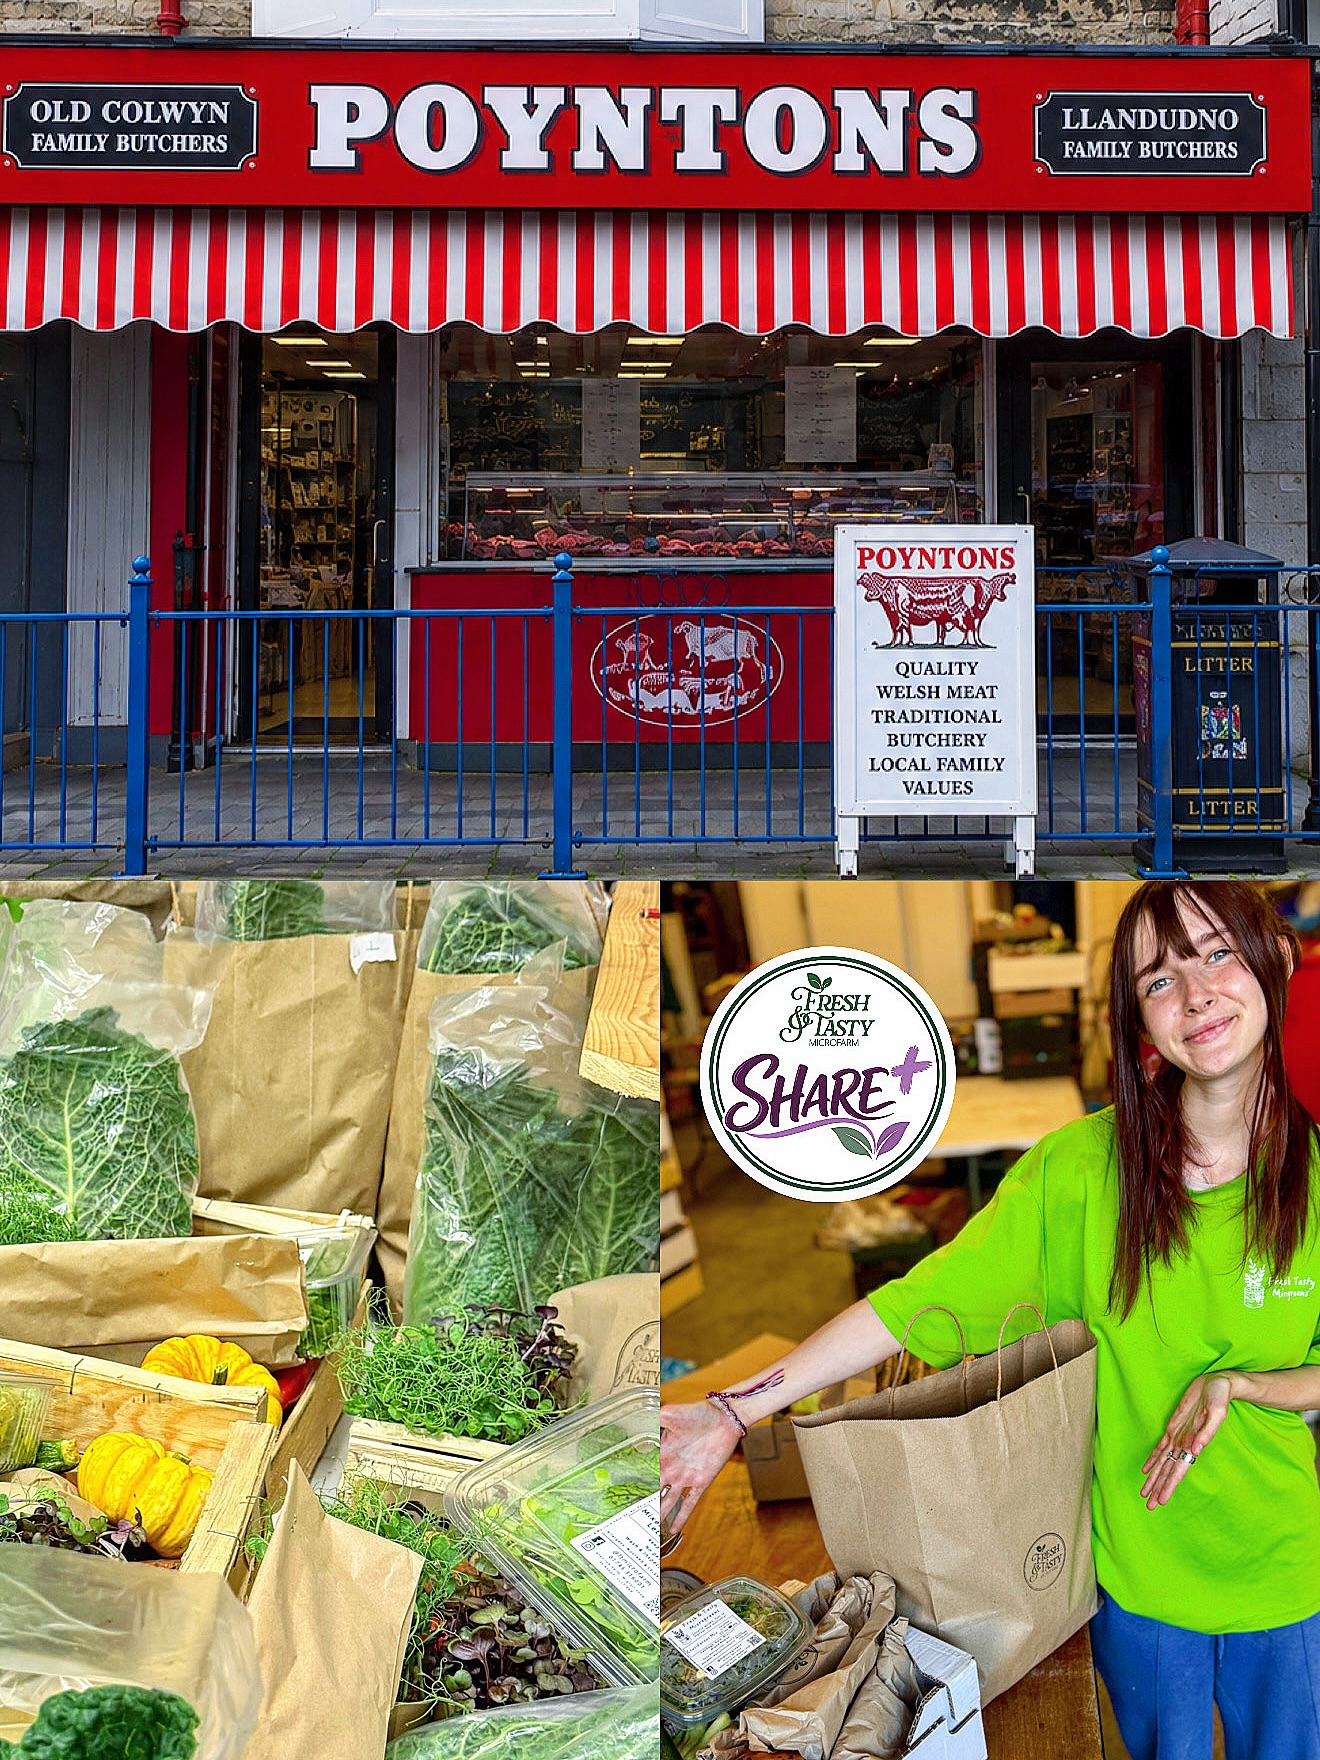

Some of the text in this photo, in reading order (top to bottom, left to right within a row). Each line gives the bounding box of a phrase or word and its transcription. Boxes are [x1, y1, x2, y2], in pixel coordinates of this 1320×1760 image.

[30, 100, 230, 124] OLD COLWYN
[1061, 108, 1240, 130] LLANDUDNO
[307, 82, 981, 176] POYNTONS
[31, 132, 228, 153] FAMILY BUTCHERS
[1063, 140, 1238, 159] FAMILY BUTCHERS
[856, 546, 1016, 570] POYNTONS
[895, 661, 979, 678] QUALITY
[1184, 656, 1255, 672] LITTER
[876, 685, 999, 699] WELSH MEAT
[871, 709, 1002, 724] TRADITIONAL
[886, 733, 987, 747] BUTCHERY
[868, 757, 1006, 772] LOCAL FAMILY
[902, 780, 974, 795] VALUES
[1188, 800, 1259, 815] LITTER
[1293, 1276, 1316, 1291] Tasty
